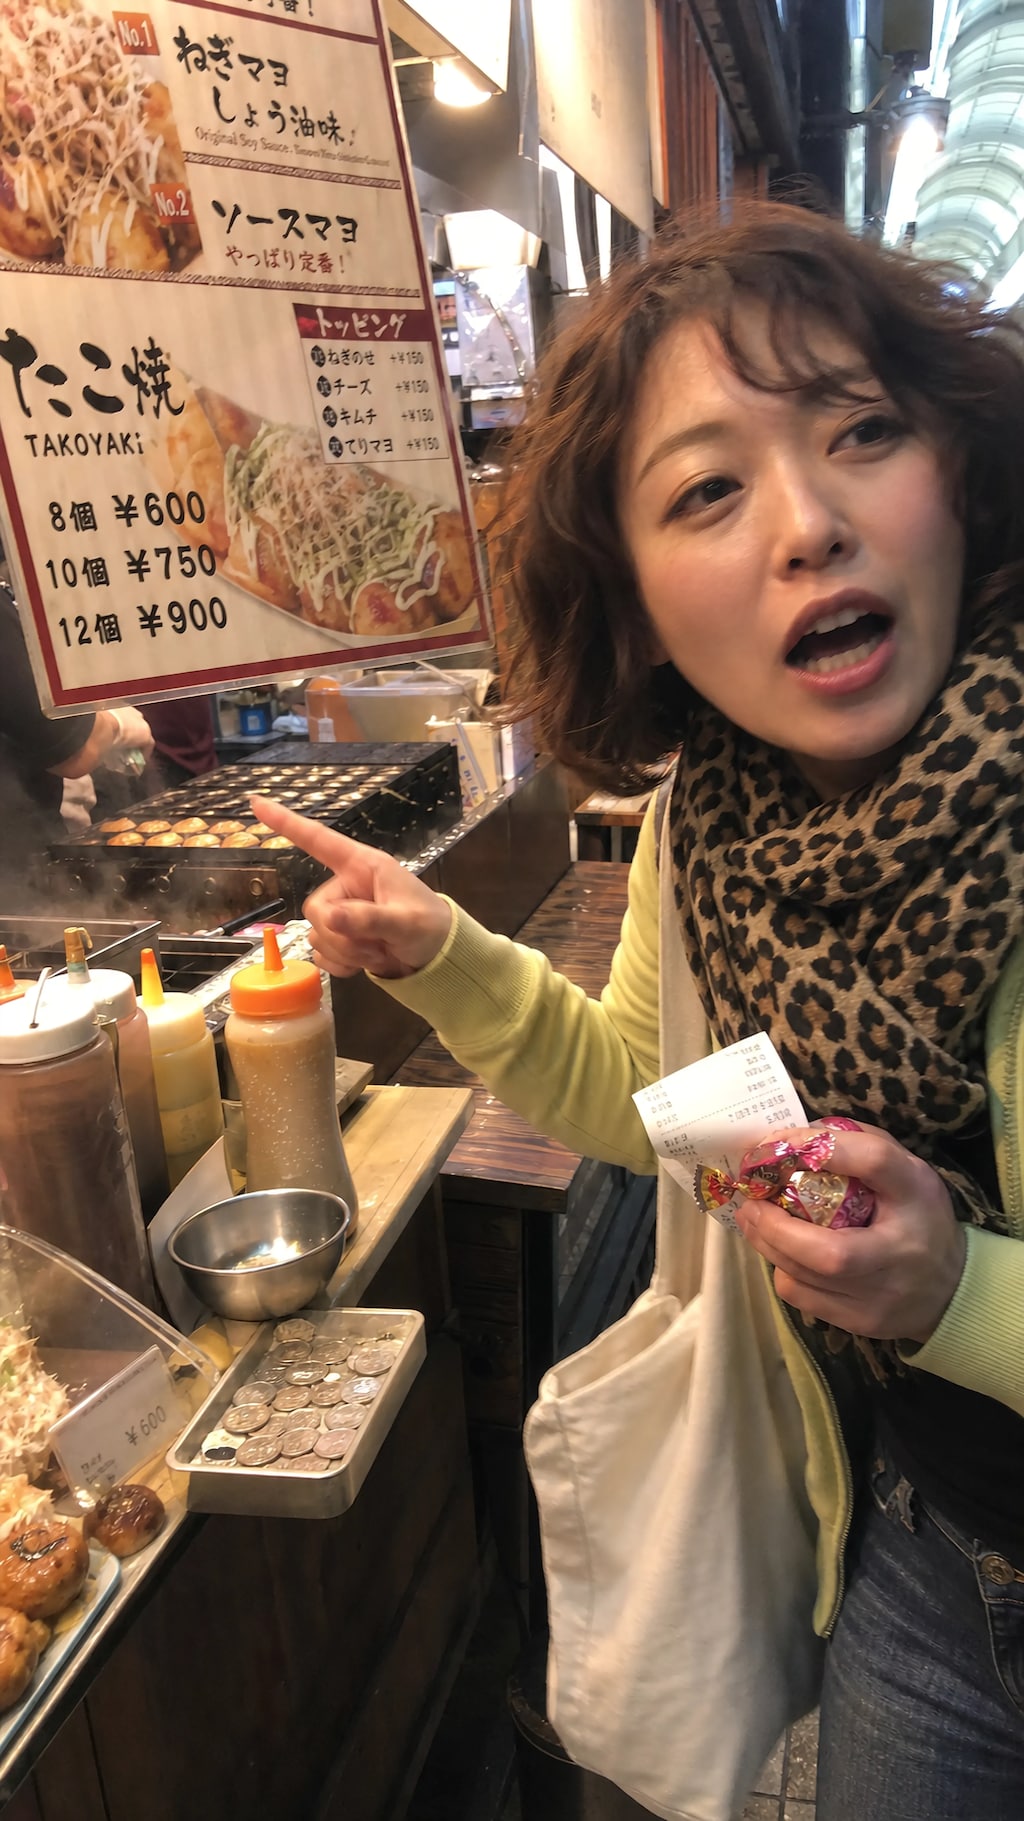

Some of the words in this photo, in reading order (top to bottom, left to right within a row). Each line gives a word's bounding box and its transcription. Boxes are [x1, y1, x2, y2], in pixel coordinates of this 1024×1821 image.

[118, 20, 152, 47] No.1
[173, 26, 289, 87] ねぎマヨ
[155, 189, 189, 217] No.2
[211, 200, 358, 243] ソースマヨ
[225, 245, 346, 274] やっぱり定番!
[316, 307, 407, 338] トッピング
[328, 349, 376, 366] ねぎのせ
[389, 351, 425, 365] +¥150
[0, 328, 185, 419] たこ焼
[333, 378, 372, 395] チーズ
[395, 379, 430, 394] +¥150
[340, 408, 377, 425] キムチ
[401, 408, 435, 423] +¥150
[345, 438, 394, 455] てりマヨ
[406, 437, 440, 451] +¥150
[49, 501, 98, 532] 8個
[112, 491, 205, 528] ¥600
[45, 556, 110, 589] 10個
[124, 544, 216, 583] ¥750
[59, 613, 122, 647] 12個
[136, 596, 227, 638] ¥900
